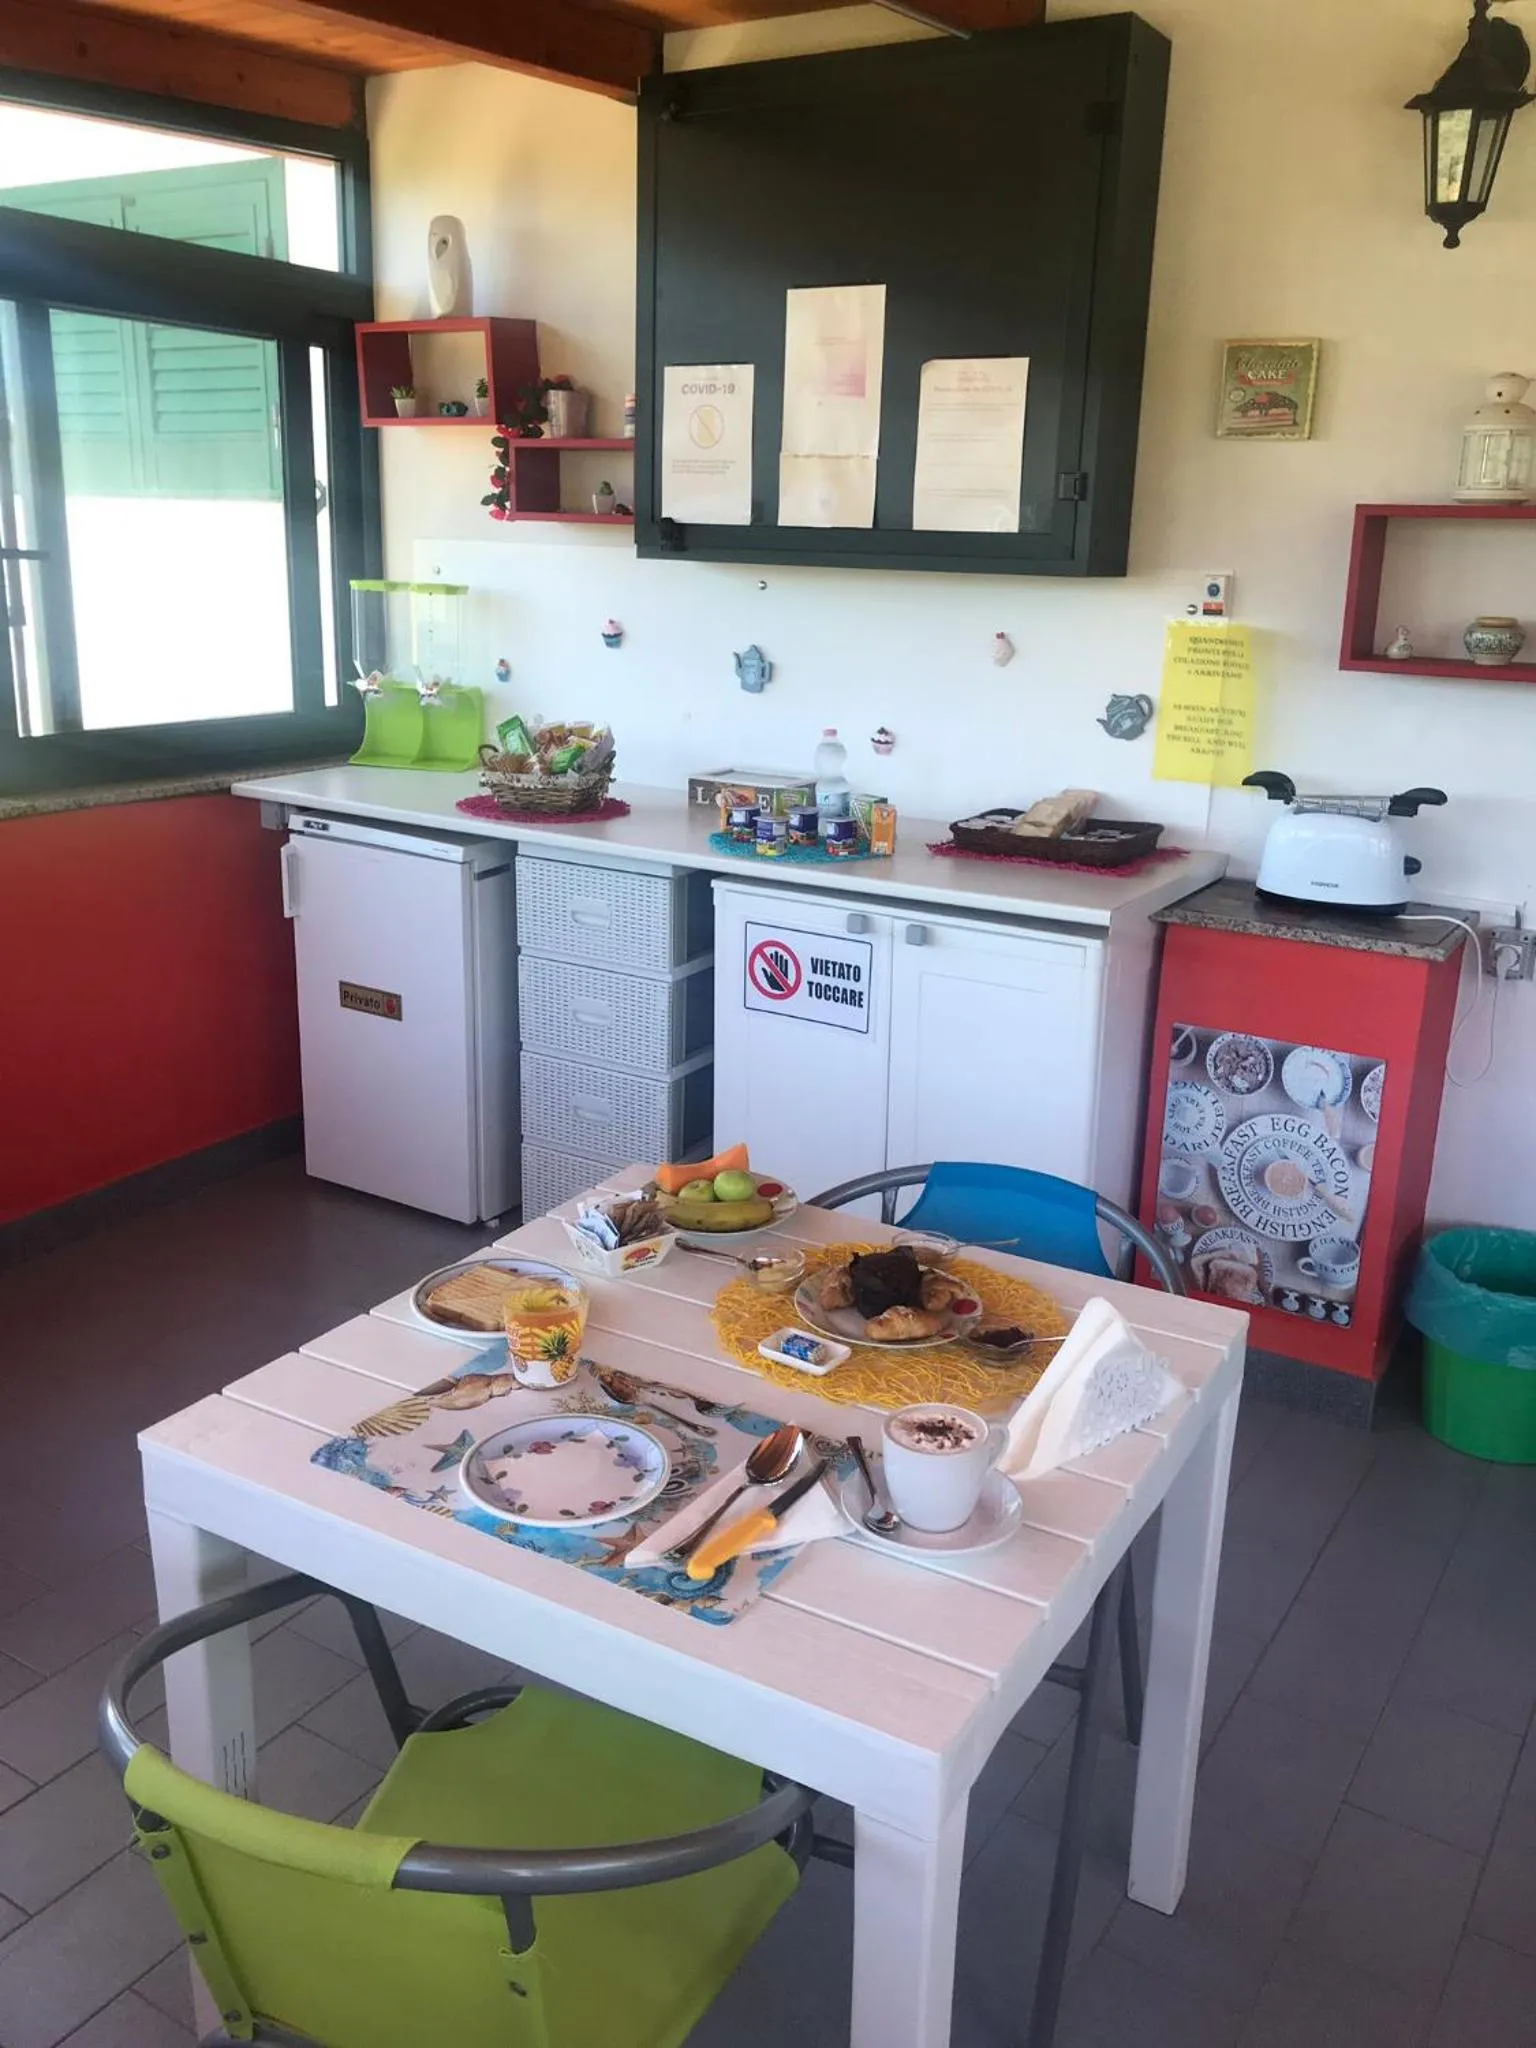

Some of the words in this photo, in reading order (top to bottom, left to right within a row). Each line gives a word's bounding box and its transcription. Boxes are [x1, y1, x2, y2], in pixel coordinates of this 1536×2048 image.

[1248, 369, 1288, 380] CAKE
[681, 383, 736, 395] COVID-19
[810, 956, 861, 983] VIETATO
[343, 990, 381, 1010] Privato
[806, 980, 864, 1008] TOCCARE
[1271, 1117, 1311, 1138] EGG
[1222, 1121, 1258, 1219] BREAKFAST
[1264, 1138, 1313, 1159] COFFEE
[1312, 1159, 1326, 1185] TEA
[1313, 1133, 1349, 1199] BACON
[1255, 1209, 1337, 1238] ENGLISH
